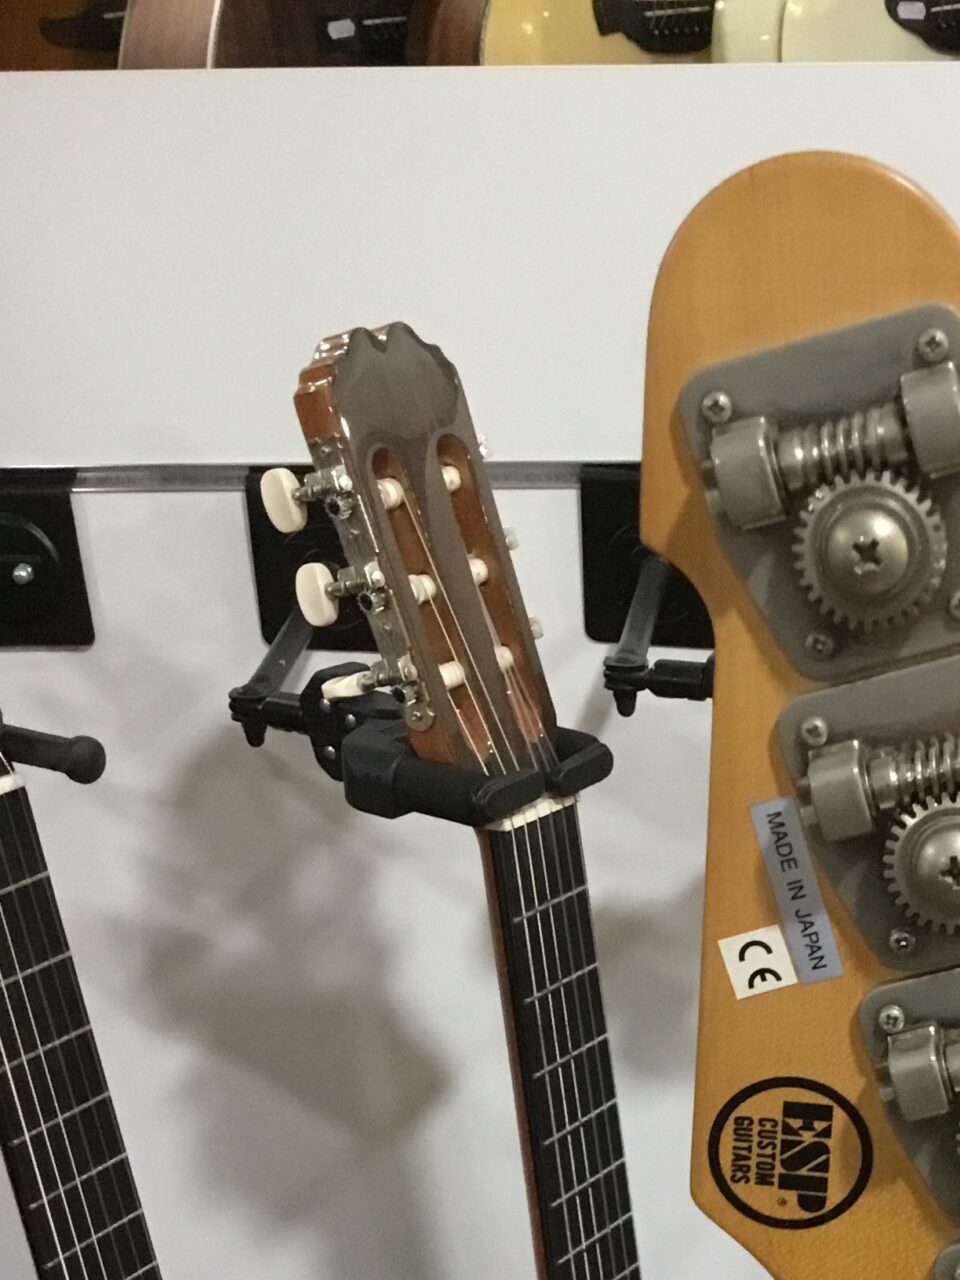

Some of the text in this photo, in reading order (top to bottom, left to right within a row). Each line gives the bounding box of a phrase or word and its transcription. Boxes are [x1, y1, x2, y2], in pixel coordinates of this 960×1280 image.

[765, 811, 829, 972] MADE IN JAPAN
[729, 1115, 755, 1186] GUITARS
[754, 1116, 779, 1188] CUSTOM
[777, 1101, 835, 1214] ESP
